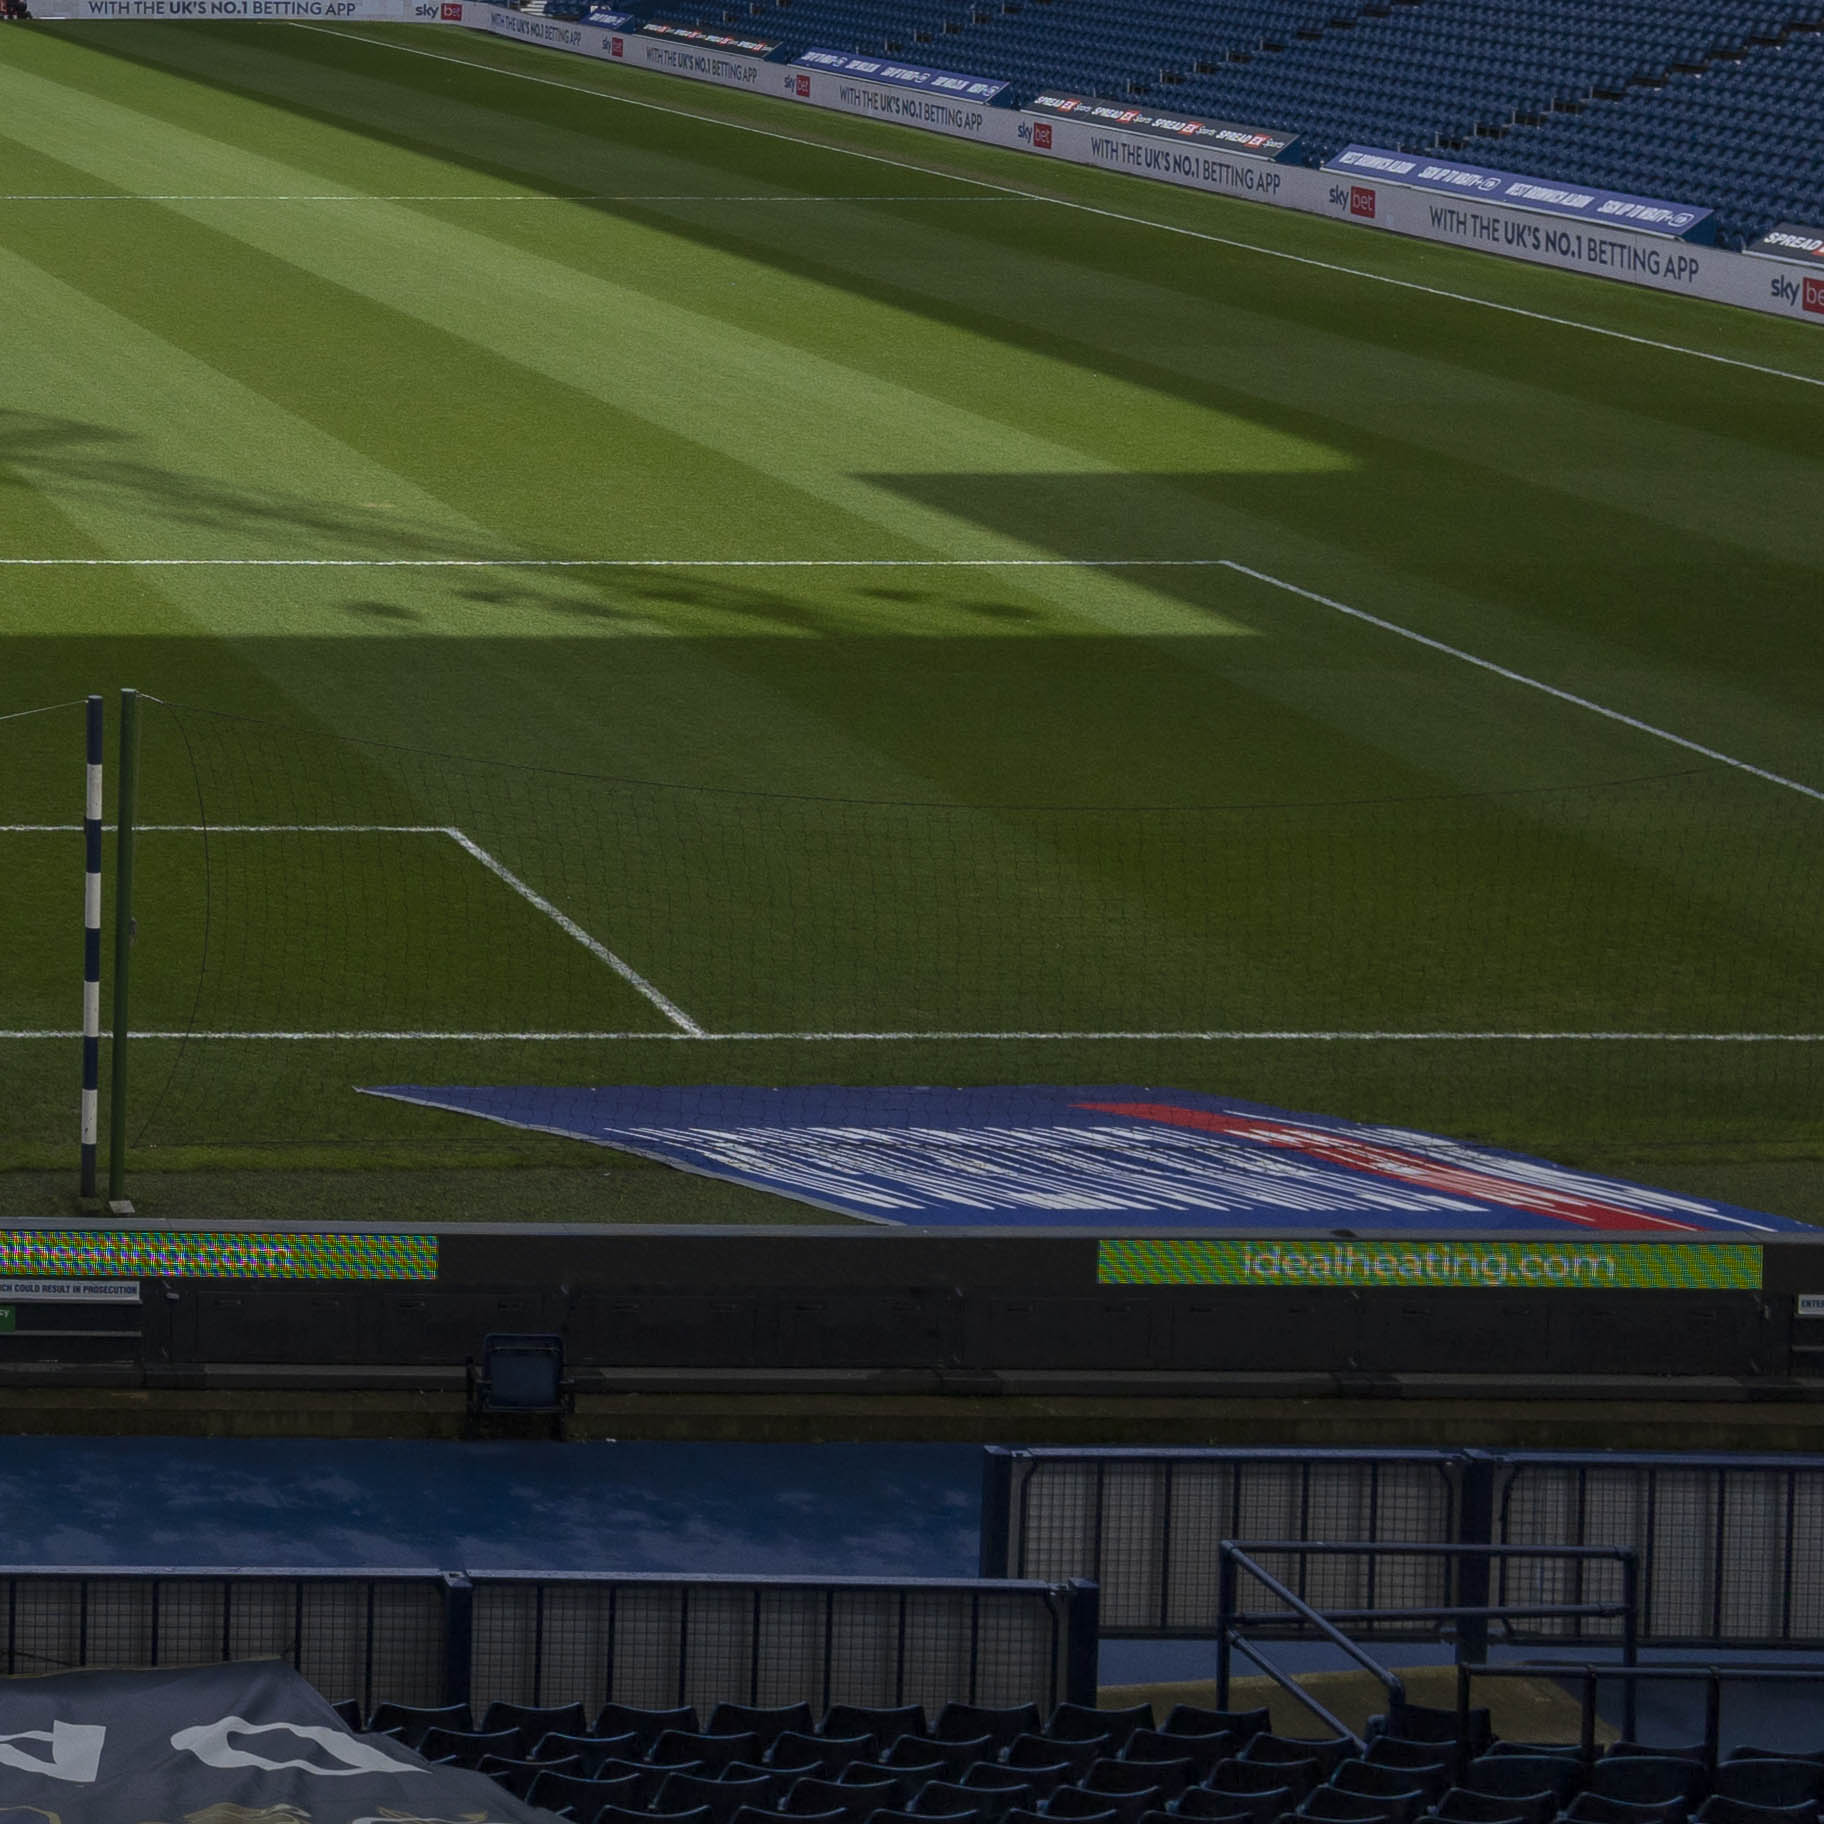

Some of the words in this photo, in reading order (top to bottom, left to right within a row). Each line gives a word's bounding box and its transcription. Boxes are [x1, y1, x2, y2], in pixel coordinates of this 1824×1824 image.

[88, 0, 130, 14] WITH
[133, 0, 165, 14] THE
[169, 0, 207, 15] UK'S
[211, 1, 248, 15] NO.1
[252, 1, 322, 15] BETTING
[325, 2, 356, 17] APP
[415, 3, 440, 18] sky
[602, 36, 611, 54] sky
[664, 49, 677, 67] THE
[677, 51, 694, 70] UK'S
[695, 55, 711, 74] NO.1
[712, 59, 742, 82] BETTING
[742, 66, 757, 84] APP
[784, 75, 796, 92] sky
[839, 85, 861, 106] WITH
[862, 88, 878, 110] THE
[880, 92, 901, 115] UK'S
[901, 97, 923, 118] NO.1
[924, 104, 963, 129] BETTING
[964, 112, 983, 132] APP
[1017, 121, 1033, 144] sky
[1090, 136, 1119, 161] WITH
[1121, 143, 1143, 166] THE
[1144, 147, 1170, 172] UK'S
[1173, 154, 1200, 179] NO.1
[1203, 159, 1254, 190] BETTING
[1255, 173, 1281, 195] APP
[1328, 185, 1350, 211] sky
[1352, 189, 1375, 214] bet
[1429, 205, 1467, 236] WITH
[1470, 214, 1501, 243] THE
[1503, 221, 1541, 250] UK'S
[1544, 230, 1582, 260] NO.1
[1587, 237, 1661, 276] BETTING
[1663, 255, 1699, 283] APP
[1771, 274, 1801, 307] sky
[1244, 1245, 1616, 1286] idealheating.com
[14, 1282, 41, 1295] COULD
[41, 1283, 71, 1295] RESULT
[72, 1283, 82, 1295] IN
[83, 1283, 138, 1296] PROSECUTION
